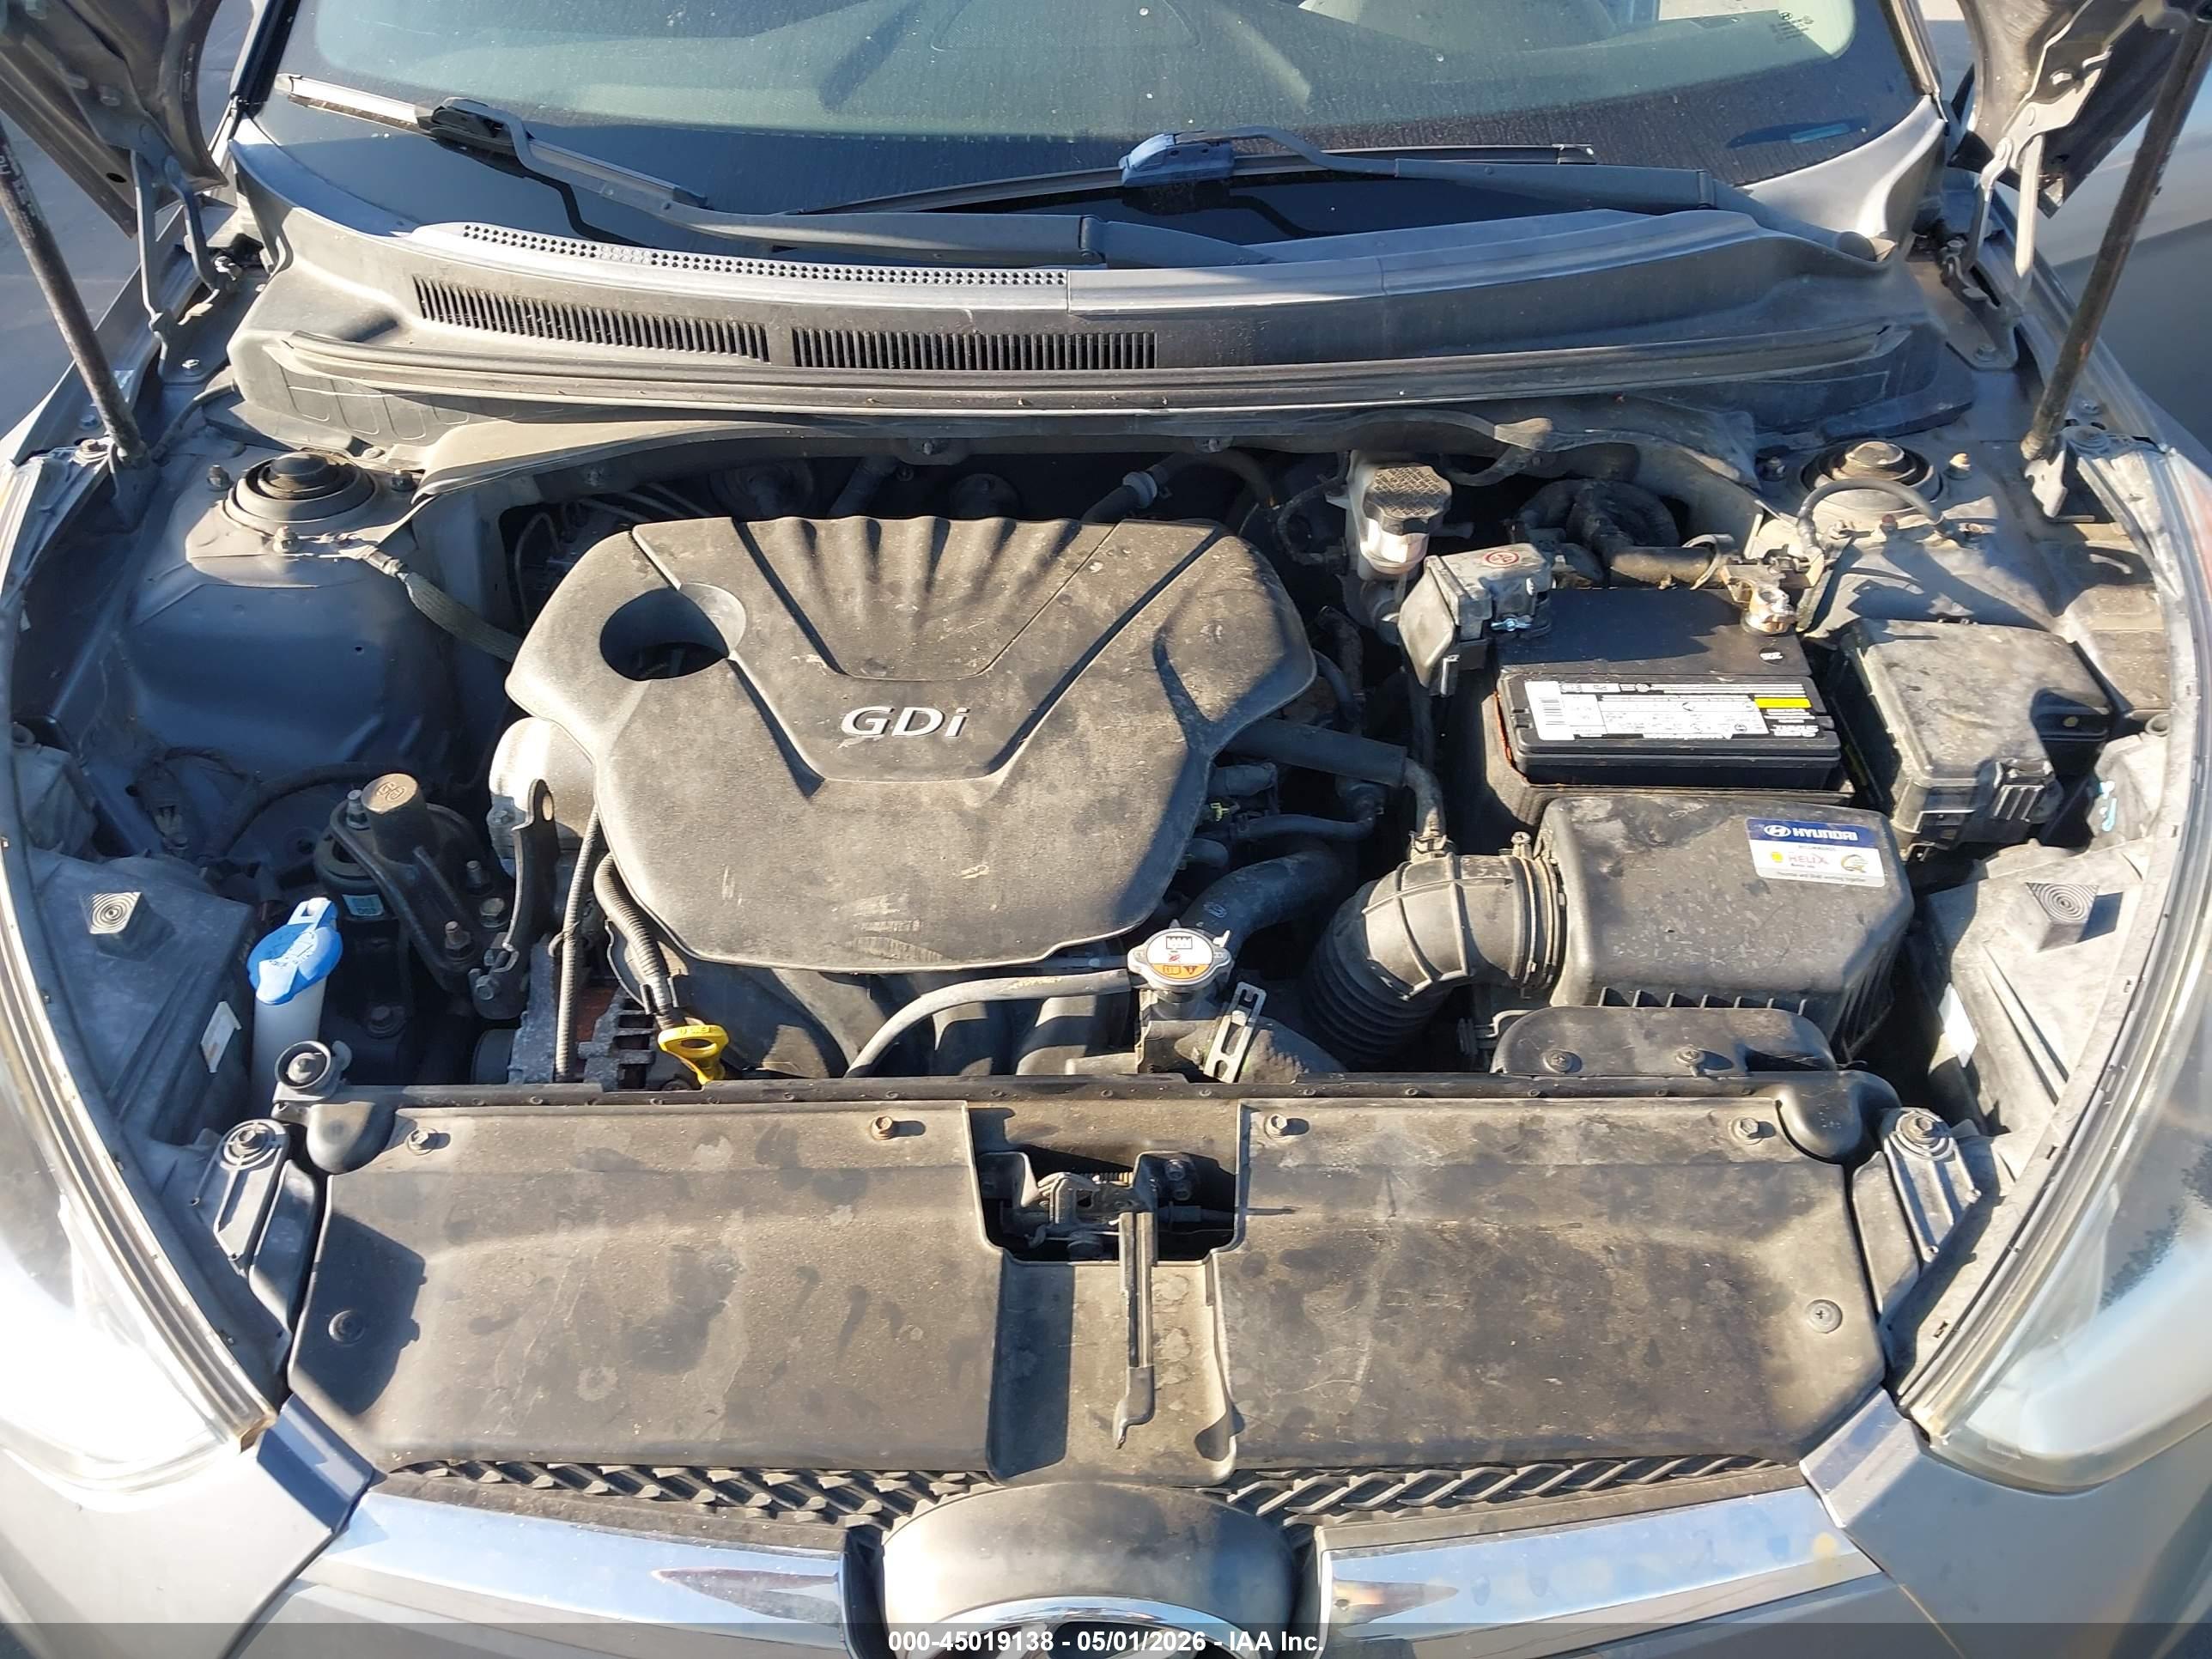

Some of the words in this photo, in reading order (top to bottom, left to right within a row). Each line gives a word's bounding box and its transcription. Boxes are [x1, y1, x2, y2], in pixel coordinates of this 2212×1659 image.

[841, 706, 970, 738] GDi
[1793, 828, 1858, 841] HYUNDAI
[1789, 853, 1829, 864] HELIX
